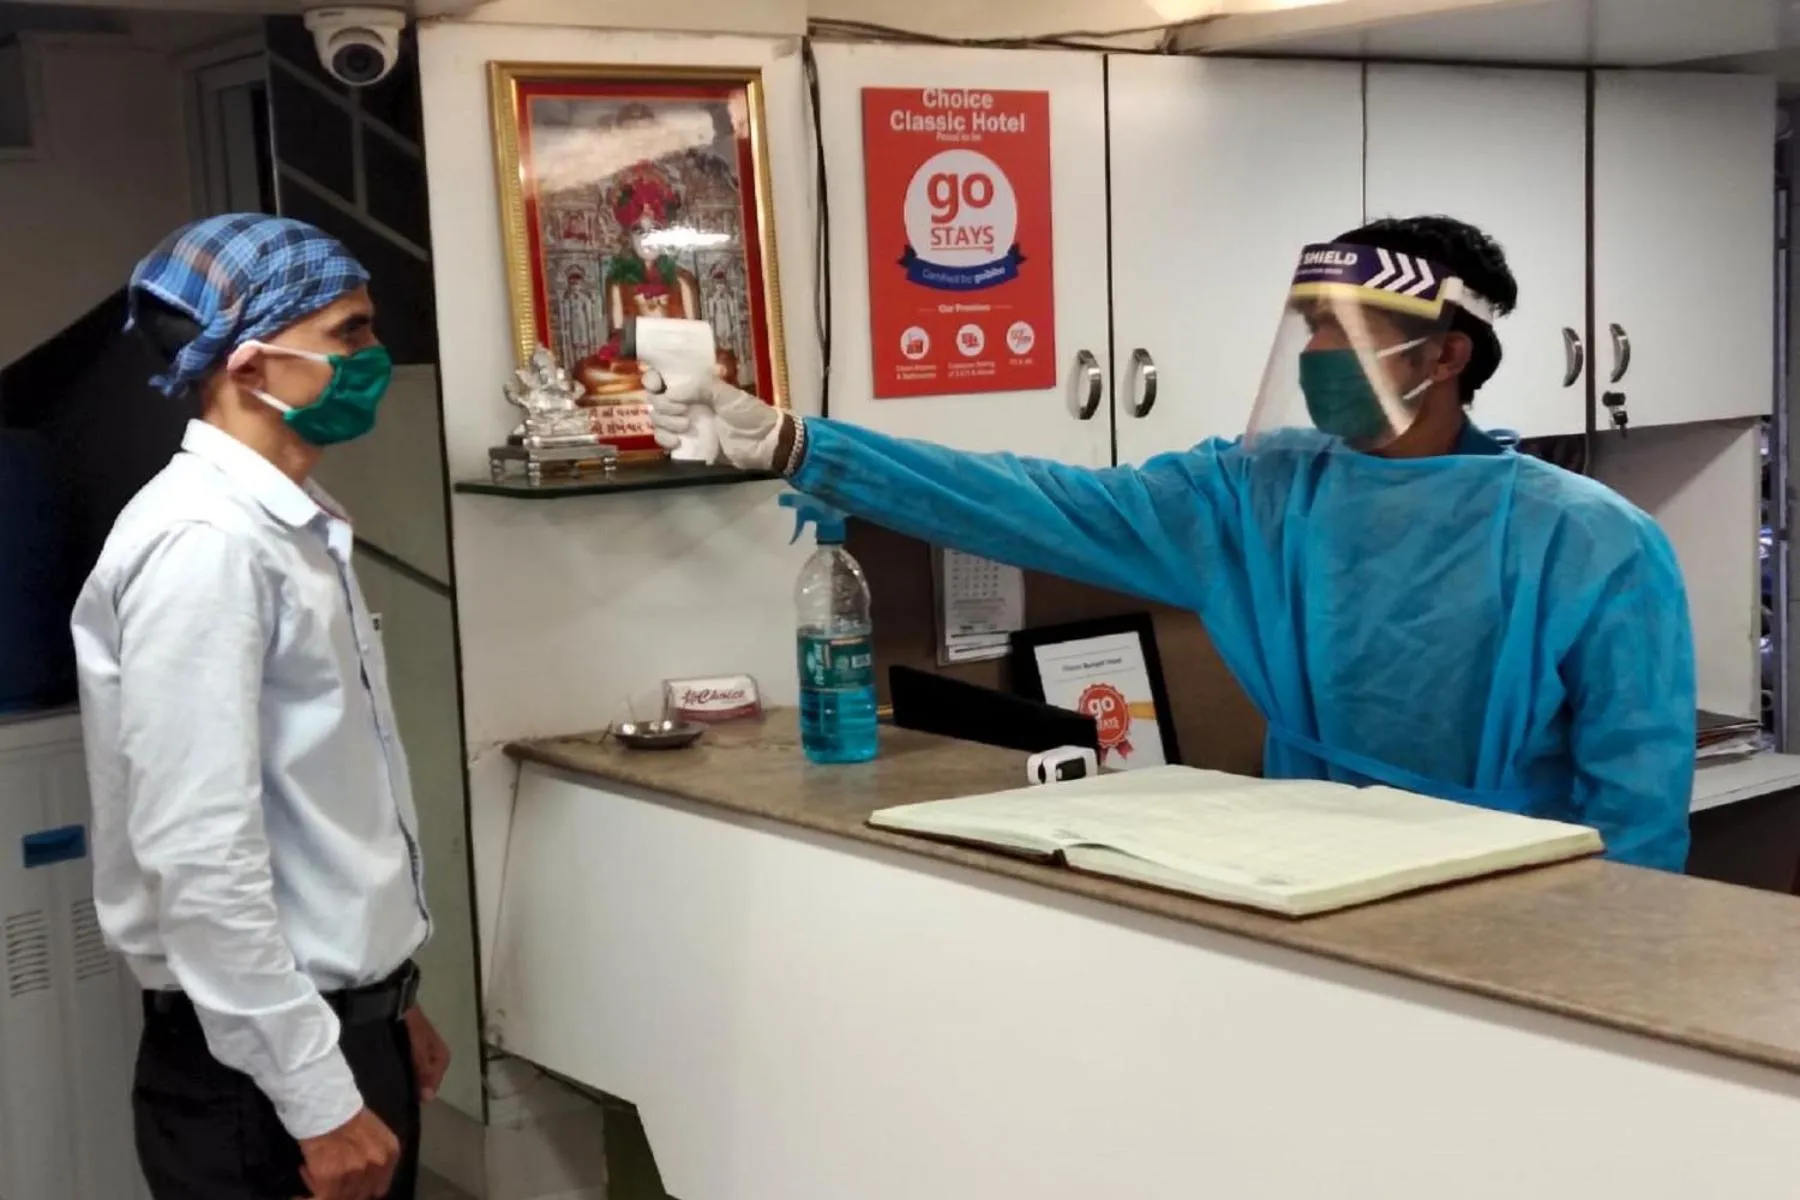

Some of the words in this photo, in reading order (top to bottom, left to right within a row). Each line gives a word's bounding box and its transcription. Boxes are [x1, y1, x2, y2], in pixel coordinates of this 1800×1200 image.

[922, 88, 994, 109] Choice
[890, 110, 966, 131] Classic
[972, 112, 1025, 132] Hotel
[928, 172, 994, 224] go
[931, 226, 994, 245] STAYS
[1304, 251, 1358, 266] SHIELD
